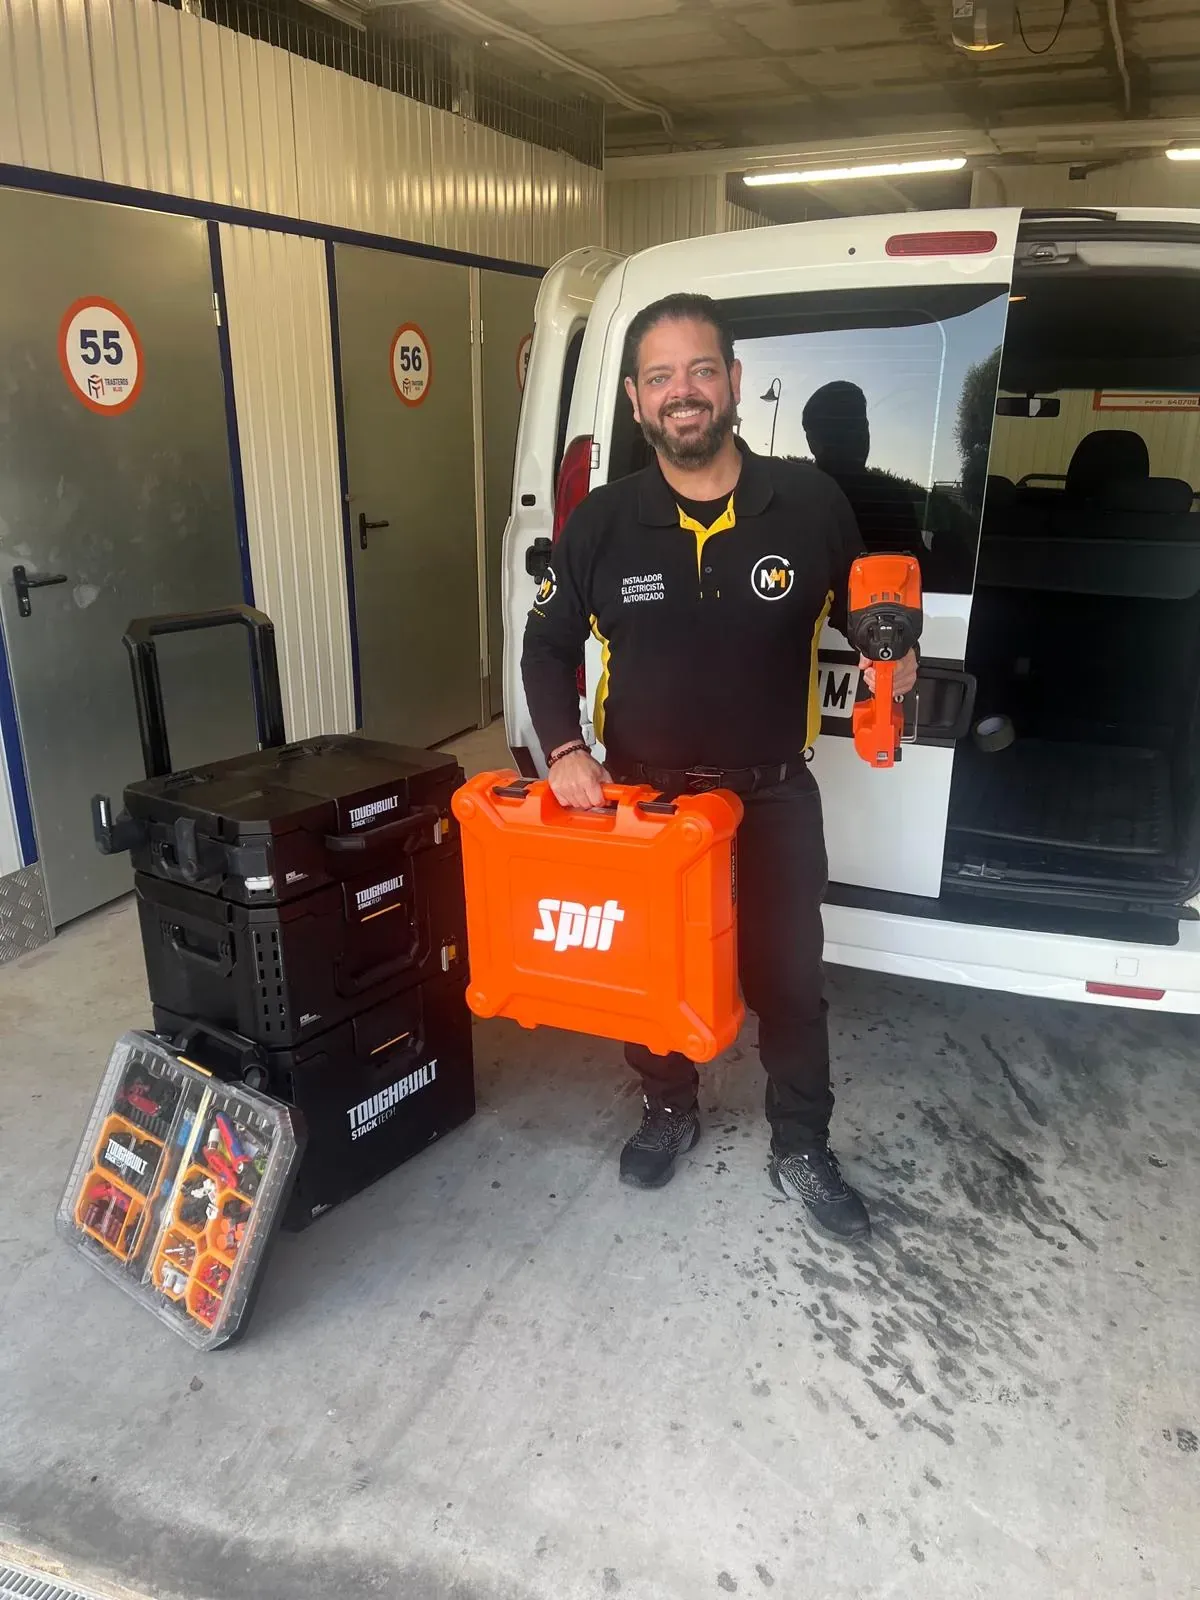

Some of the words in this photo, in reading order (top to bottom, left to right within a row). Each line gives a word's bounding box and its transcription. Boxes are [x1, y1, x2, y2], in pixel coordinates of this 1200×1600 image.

[80, 329, 123, 365] 55
[400, 346, 422, 371] 56
[621, 582, 665, 595] ELECTRICISTA
[622, 573, 663, 586] INSTALADOR
[623, 591, 665, 604] AUTORIZADO
[349, 795, 398, 822] TOUGHBUILT
[355, 874, 404, 905] TOUGHBUILT
[533, 898, 625, 952] spit
[346, 1059, 438, 1130] TOUGHBUILT
